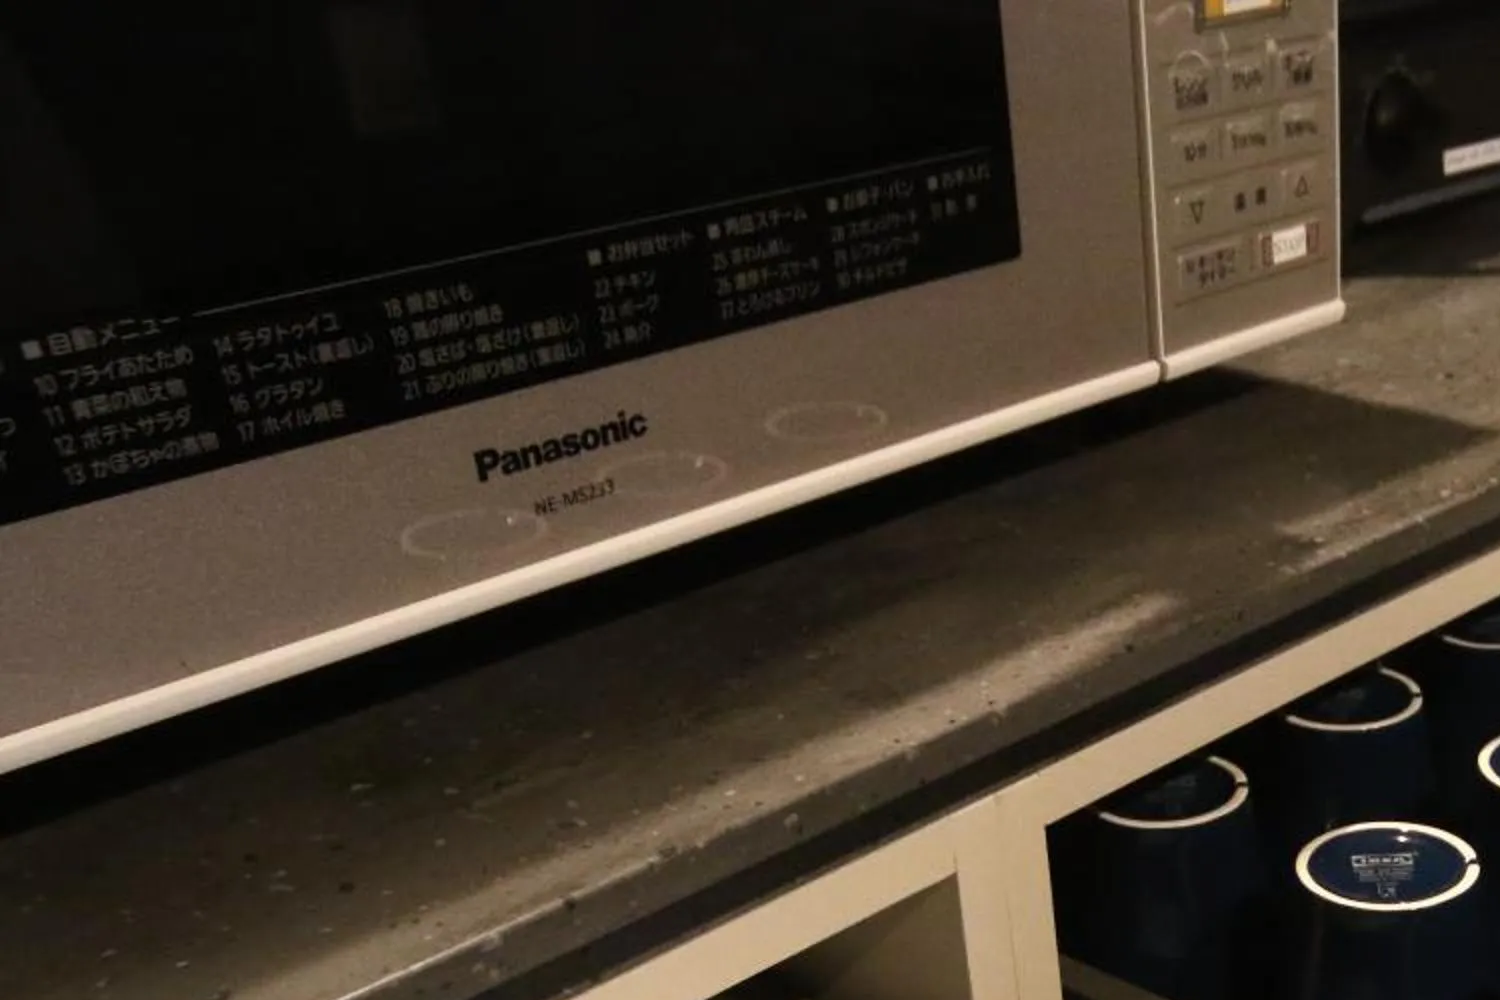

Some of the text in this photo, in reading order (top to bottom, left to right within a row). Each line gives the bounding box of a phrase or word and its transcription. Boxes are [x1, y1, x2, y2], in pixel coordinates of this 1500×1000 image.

[47, 315, 181, 356] 自動メニュー
[212, 312, 341, 357] 14 ラタトゥイユ
[33, 345, 195, 397] 10 フライあたため
[221, 364, 242, 385] 15
[229, 378, 324, 413] 16 グラタン
[43, 403, 66, 427] 11
[54, 405, 192, 457] 12 ポテトサラダ
[236, 420, 256, 442] 17
[473, 410, 649, 483] Panasonic
[63, 463, 86, 486] 13
